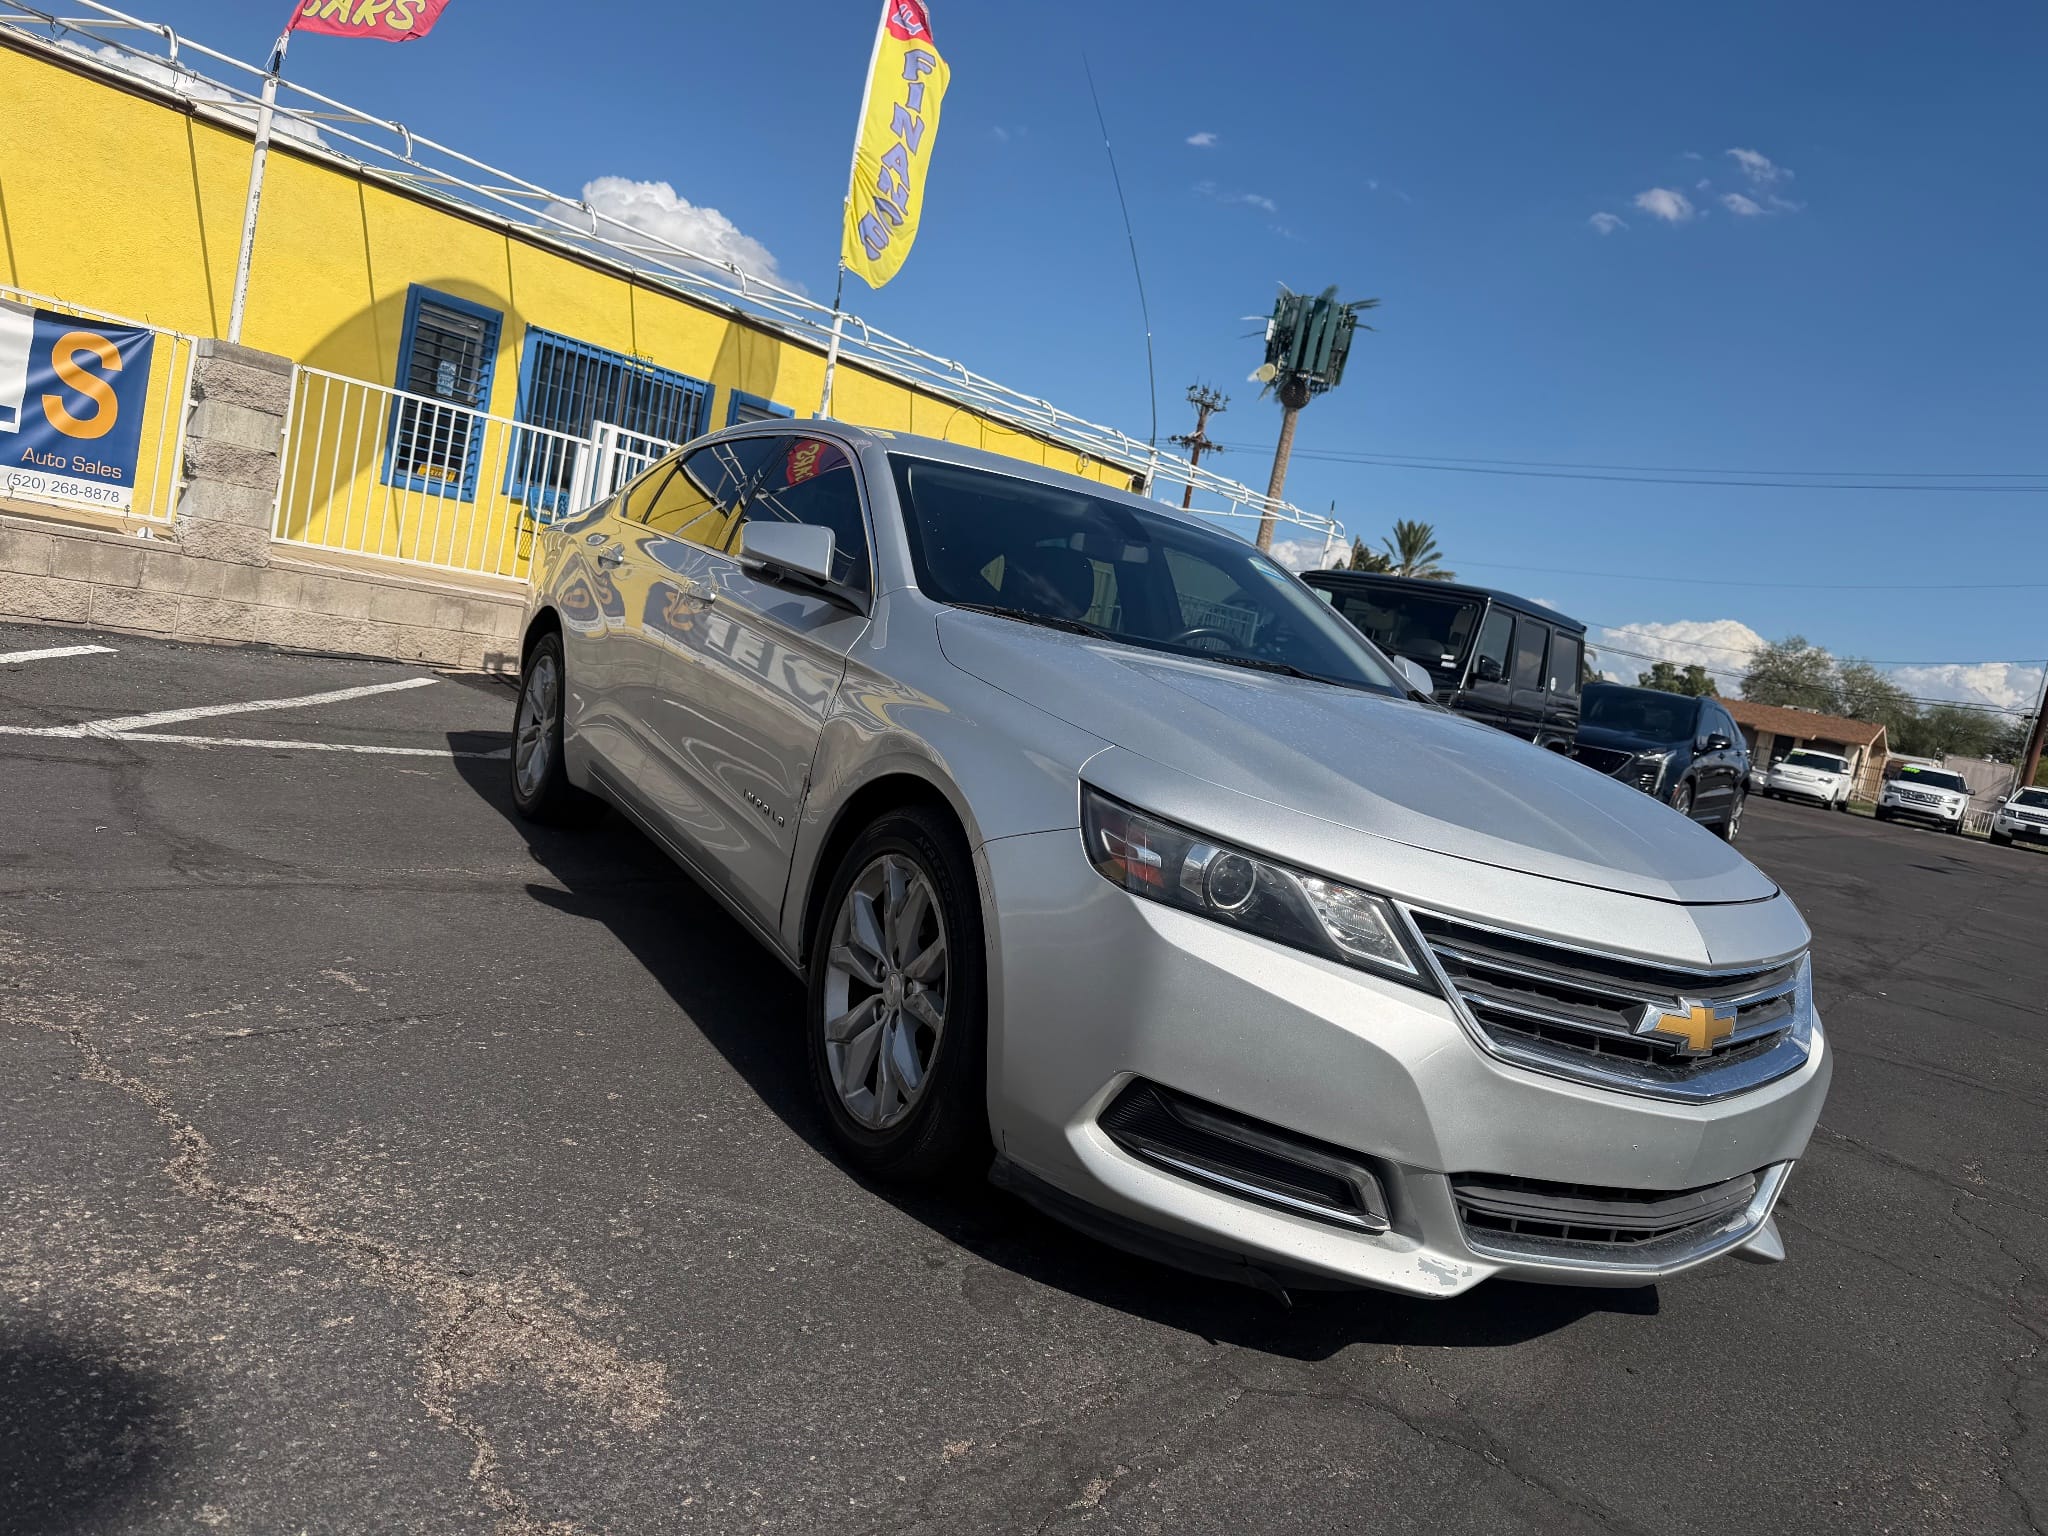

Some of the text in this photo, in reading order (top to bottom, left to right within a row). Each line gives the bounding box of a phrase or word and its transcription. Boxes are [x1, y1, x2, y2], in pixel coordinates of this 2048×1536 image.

[860, 49, 936, 261] FINANCE
[21, 447, 122, 479] Auto Sales
[7, 472, 120, 503] (520) 268-8878
[743, 788, 785, 829] IMPALA
